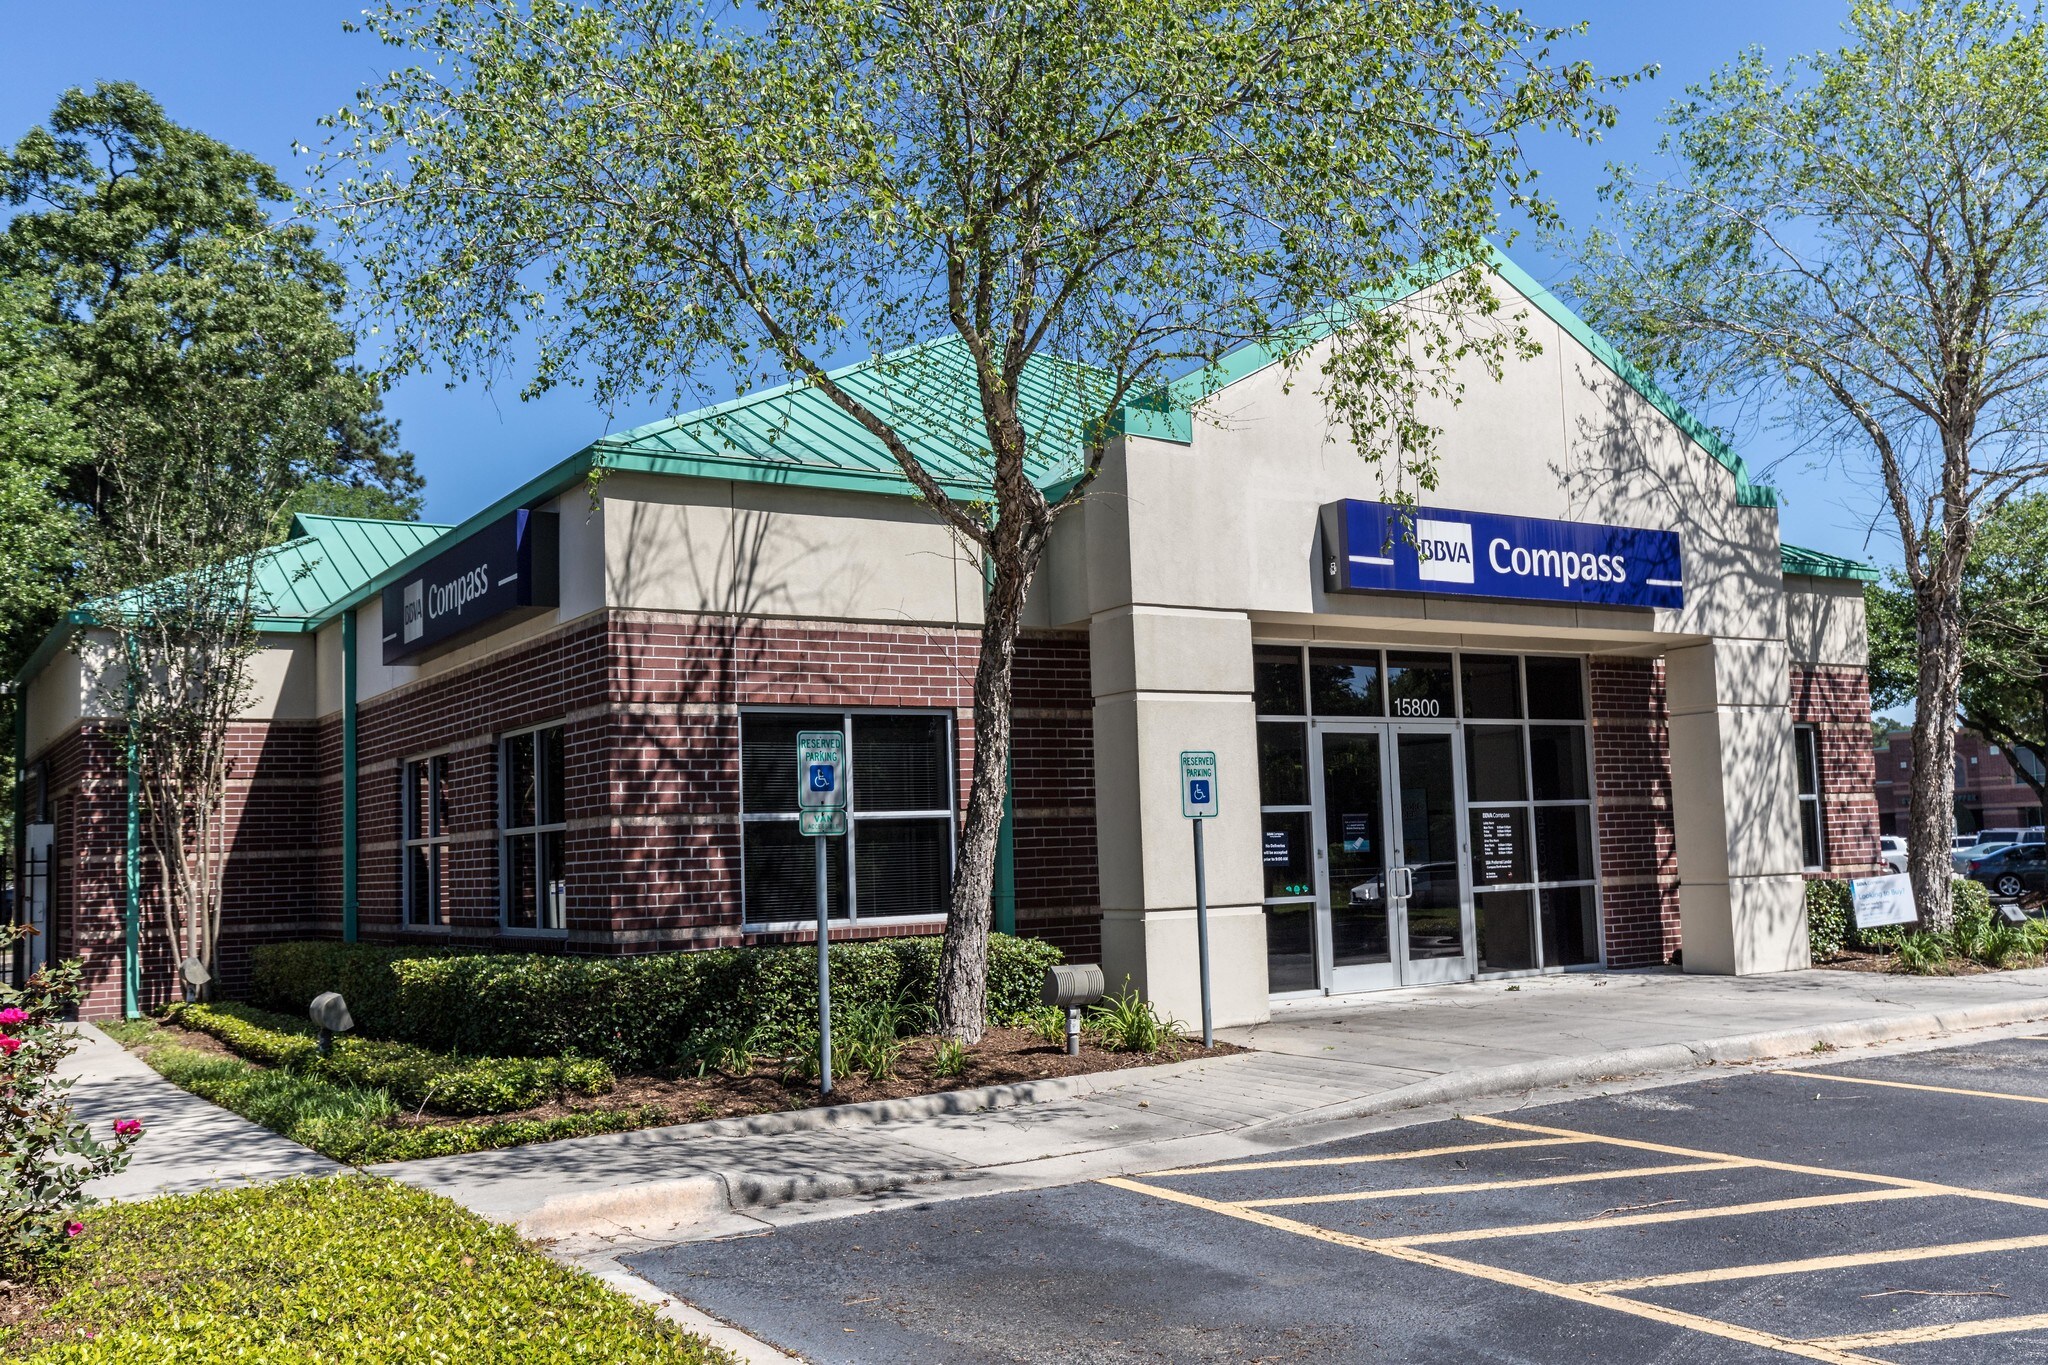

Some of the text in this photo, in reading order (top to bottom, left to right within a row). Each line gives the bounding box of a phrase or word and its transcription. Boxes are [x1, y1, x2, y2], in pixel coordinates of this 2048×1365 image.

[1420, 538, 1627, 587] BBVA Compass
[404, 563, 488, 626] BBVA Compass
[1394, 698, 1440, 717] 15800
[801, 738, 841, 749] RESERVED
[805, 752, 838, 762] PARKING
[1183, 757, 1213, 766] RESERVED
[1186, 769, 1212, 777] PARKING
[813, 815, 833, 823] VAN
[1858, 891, 1883, 900] Looking
